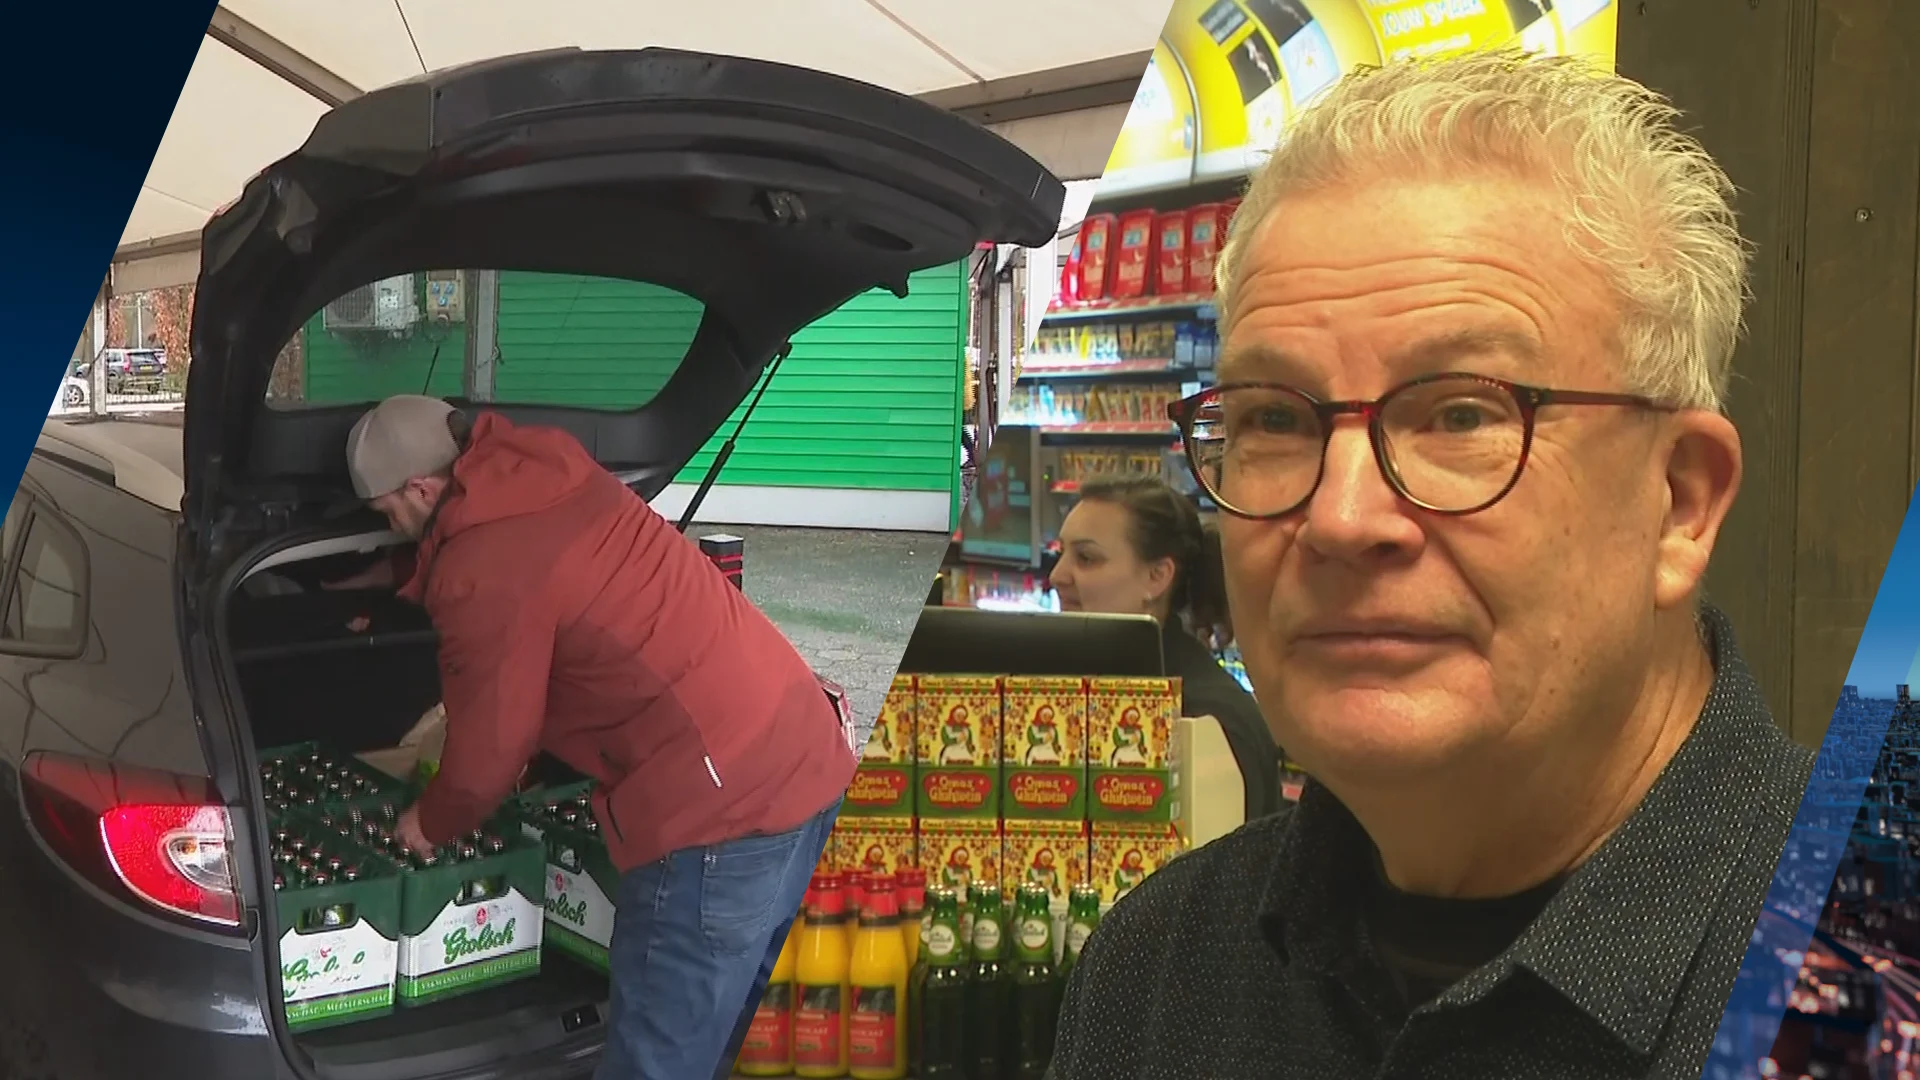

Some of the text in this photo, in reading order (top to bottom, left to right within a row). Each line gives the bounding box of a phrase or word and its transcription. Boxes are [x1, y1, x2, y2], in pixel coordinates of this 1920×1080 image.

[1382, 8, 1425, 37] JOUW
[442, 917, 517, 965] Grolsch
[326, 992, 388, 1012] MEESTERSCHAP
